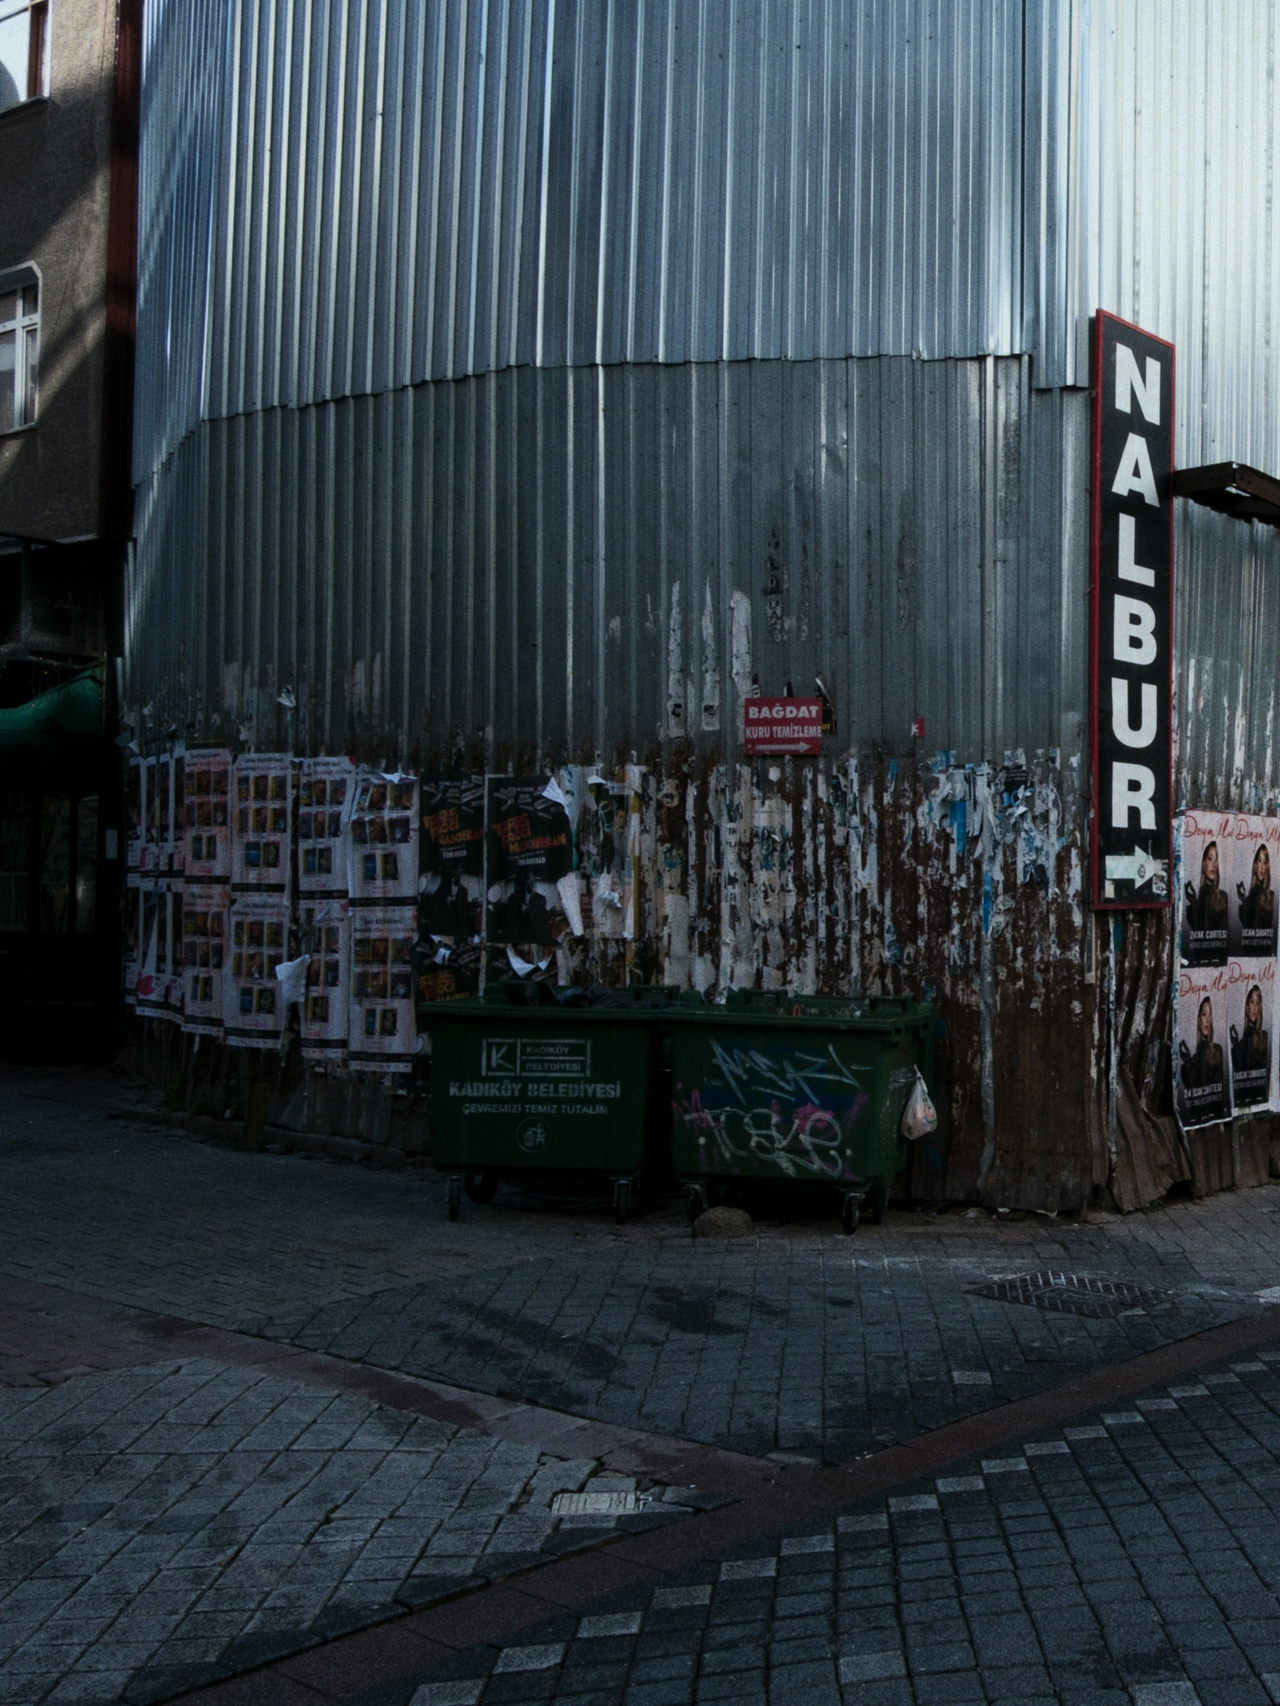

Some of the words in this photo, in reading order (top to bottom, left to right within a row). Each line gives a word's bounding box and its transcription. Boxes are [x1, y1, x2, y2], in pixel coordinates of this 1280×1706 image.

[1111, 341, 1162, 831] NALBUR
[748, 703, 819, 719] BAĞDAT
[745, 725, 771, 738] KURU
[772, 723, 822, 738] TEMİZLEME
[526, 1046, 570, 1054] KADIKÖY
[526, 1061, 581, 1071] BELEDİYESİ
[449, 1079, 522, 1097] KADIKÖY
[527, 1080, 621, 1098] BELEDİYESİ
[462, 1103, 521, 1115] ÇEVREMİZİ
[525, 1103, 557, 1113] TEMİZ
[561, 1104, 608, 1114] TUTALIM
